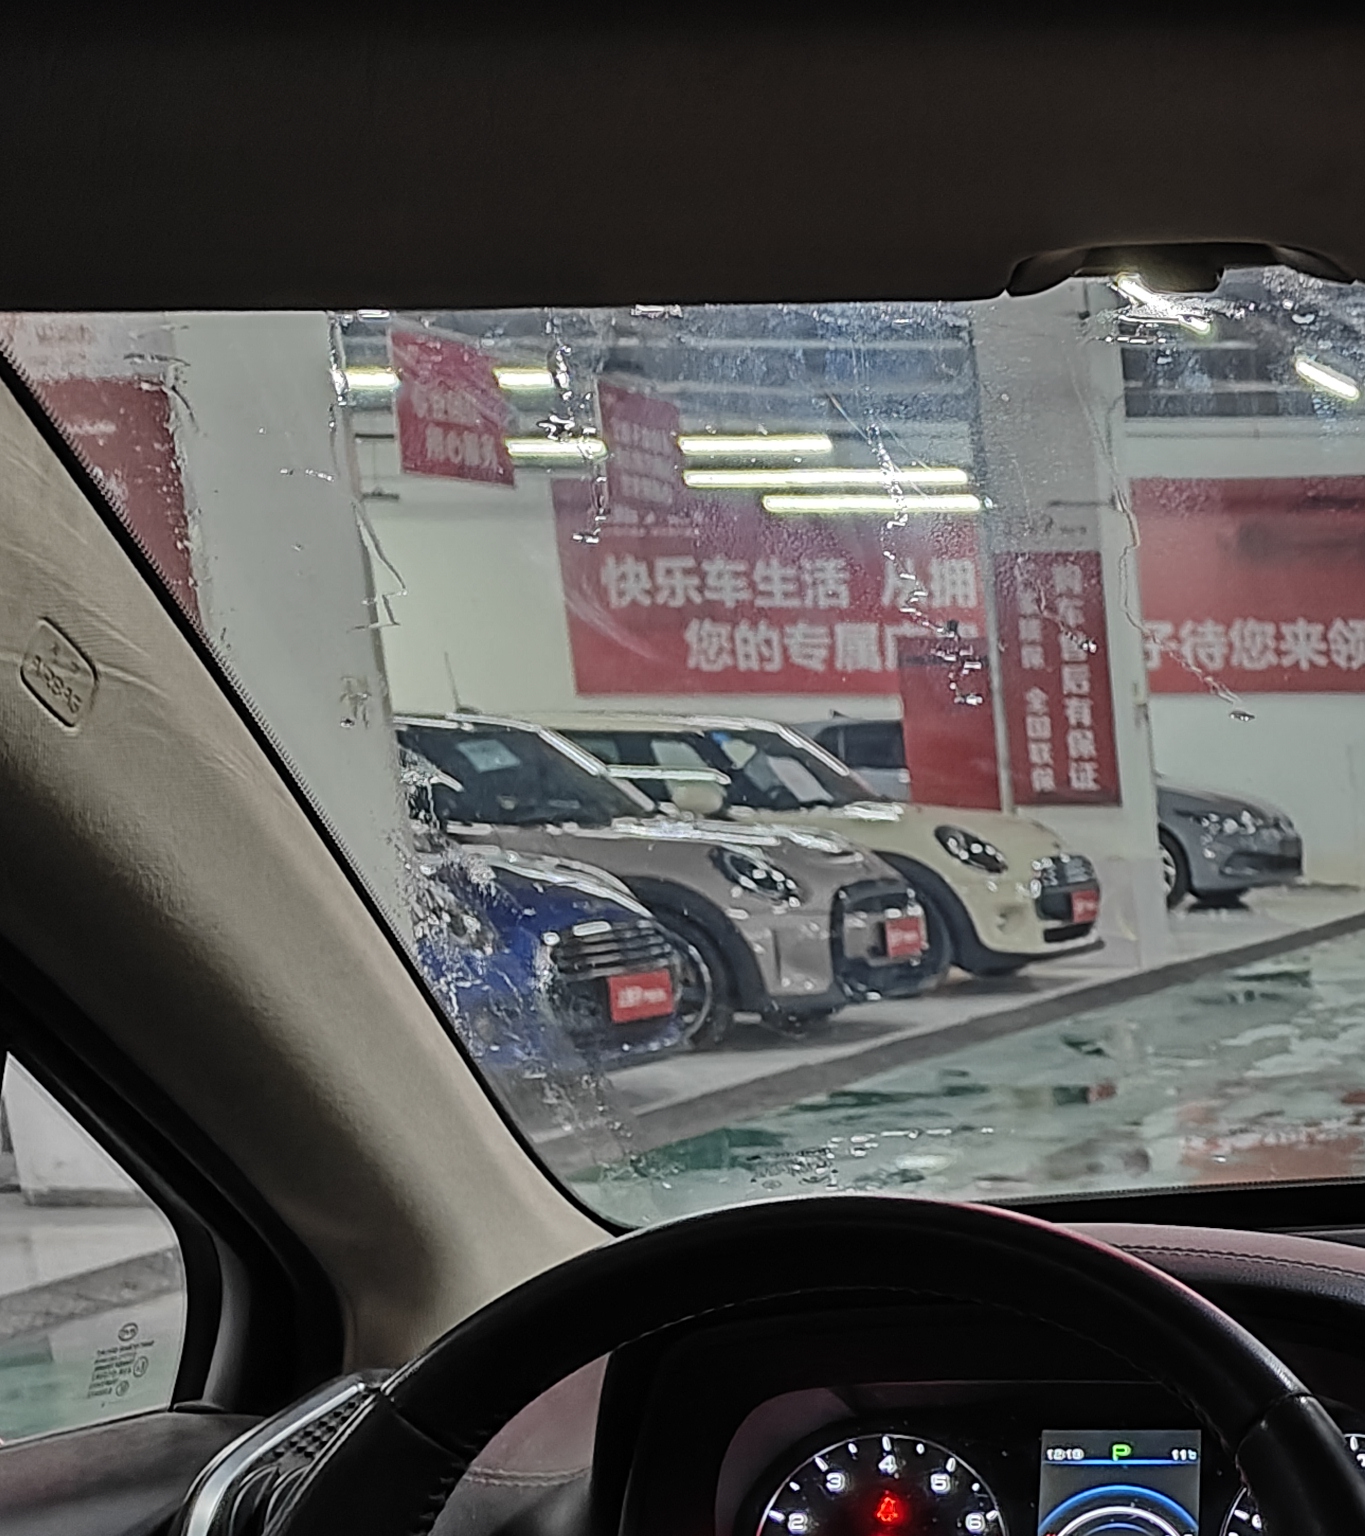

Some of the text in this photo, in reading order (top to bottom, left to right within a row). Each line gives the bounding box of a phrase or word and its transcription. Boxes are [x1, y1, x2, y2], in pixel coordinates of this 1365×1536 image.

[601, 555, 850, 607] 快乐车生活
[1112, 1444, 1132, 1462] P
[878, 1455, 897, 1473] 4
[826, 1473, 846, 1491] 3
[930, 1474, 951, 1493] 5
[787, 1513, 809, 1533] 2
[965, 1513, 985, 1532] 6
